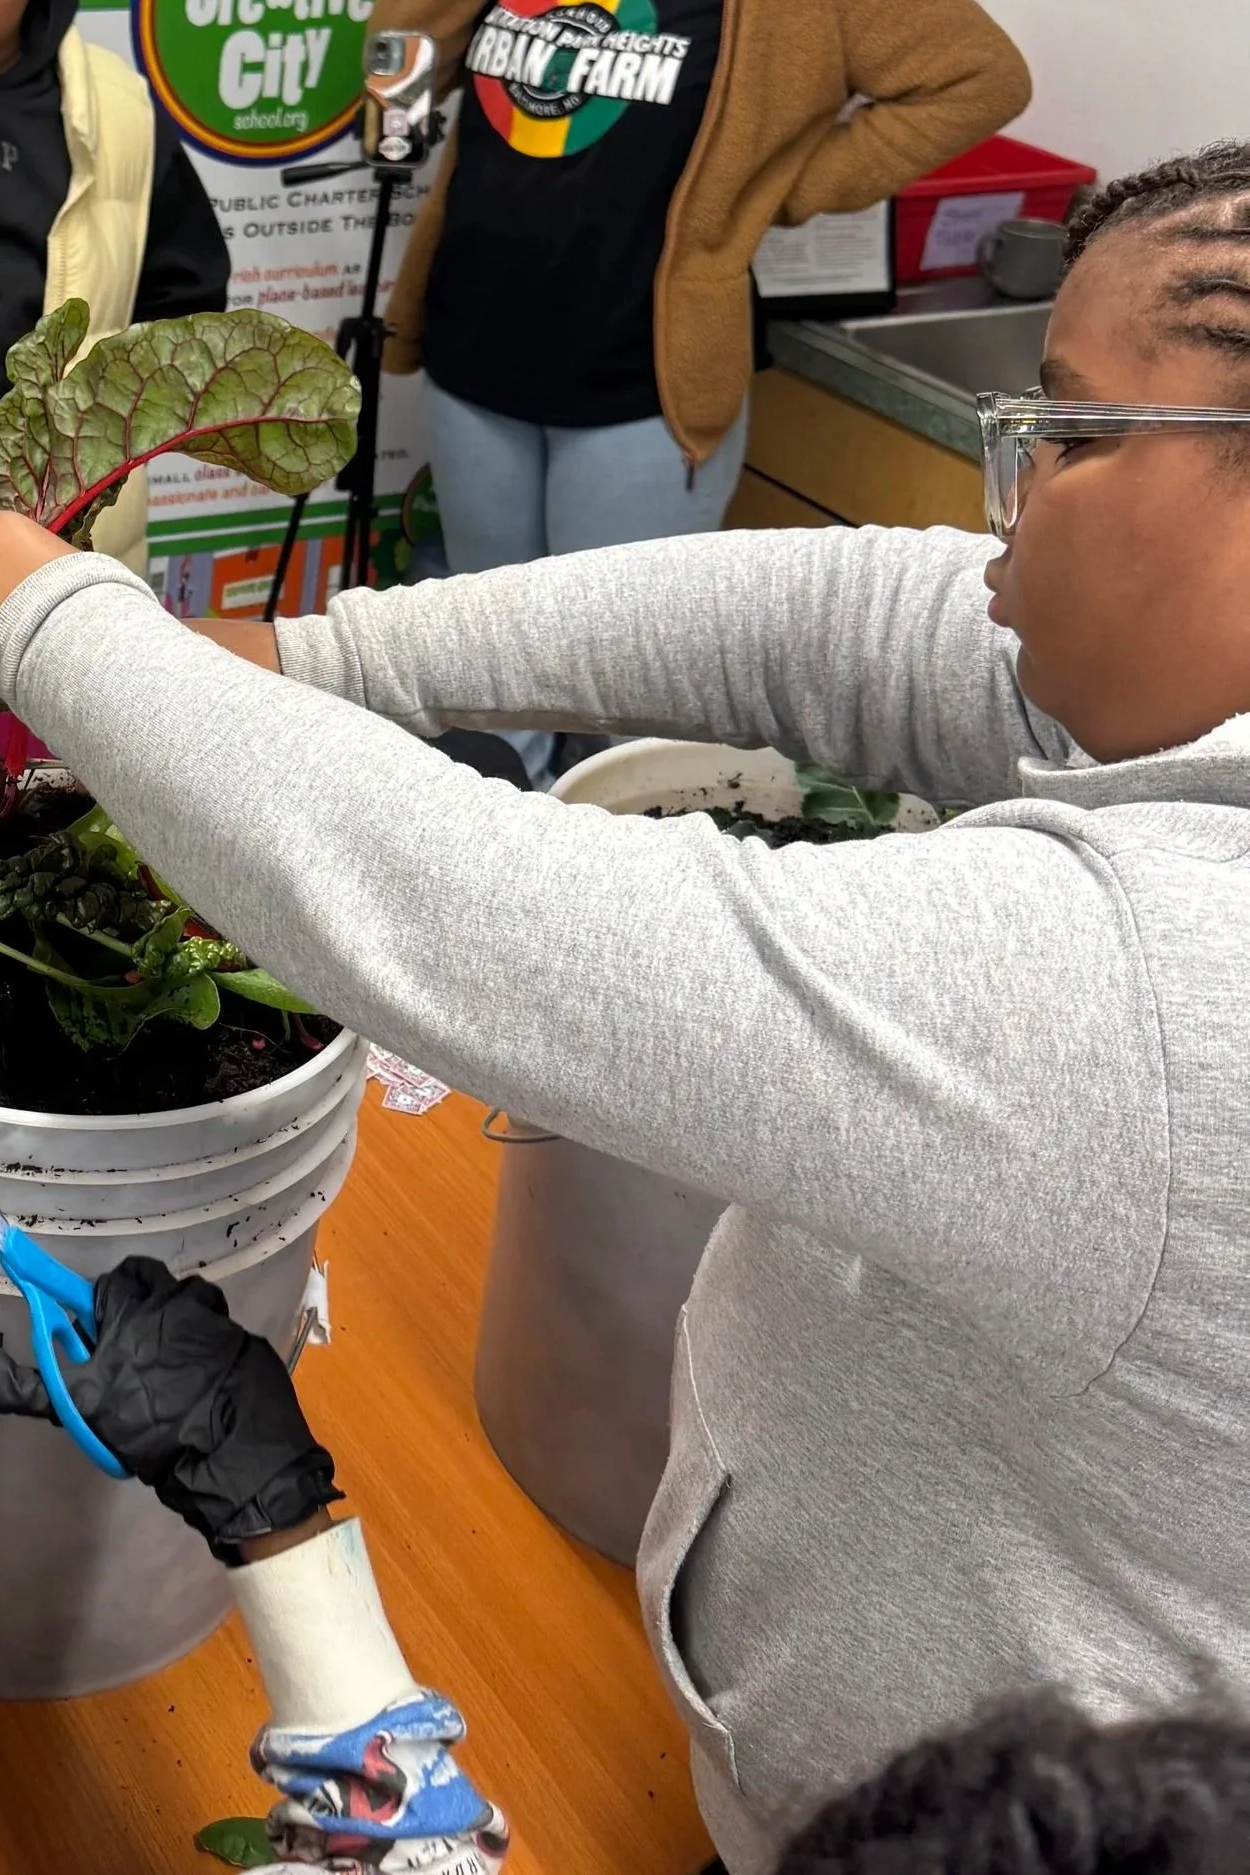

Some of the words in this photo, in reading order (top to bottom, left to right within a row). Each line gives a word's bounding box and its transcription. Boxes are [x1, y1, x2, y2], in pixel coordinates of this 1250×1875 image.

[601, 29, 691, 60] HEIGHTS
[218, 28, 333, 110] City
[566, 47, 684, 105] FARM
[233, 108, 309, 133] school.org
[287, 187, 381, 209] CHARTER
[390, 184, 429, 200] SCH
[243, 219, 332, 239] OUTSIDE
[388, 212, 414, 228] BO
